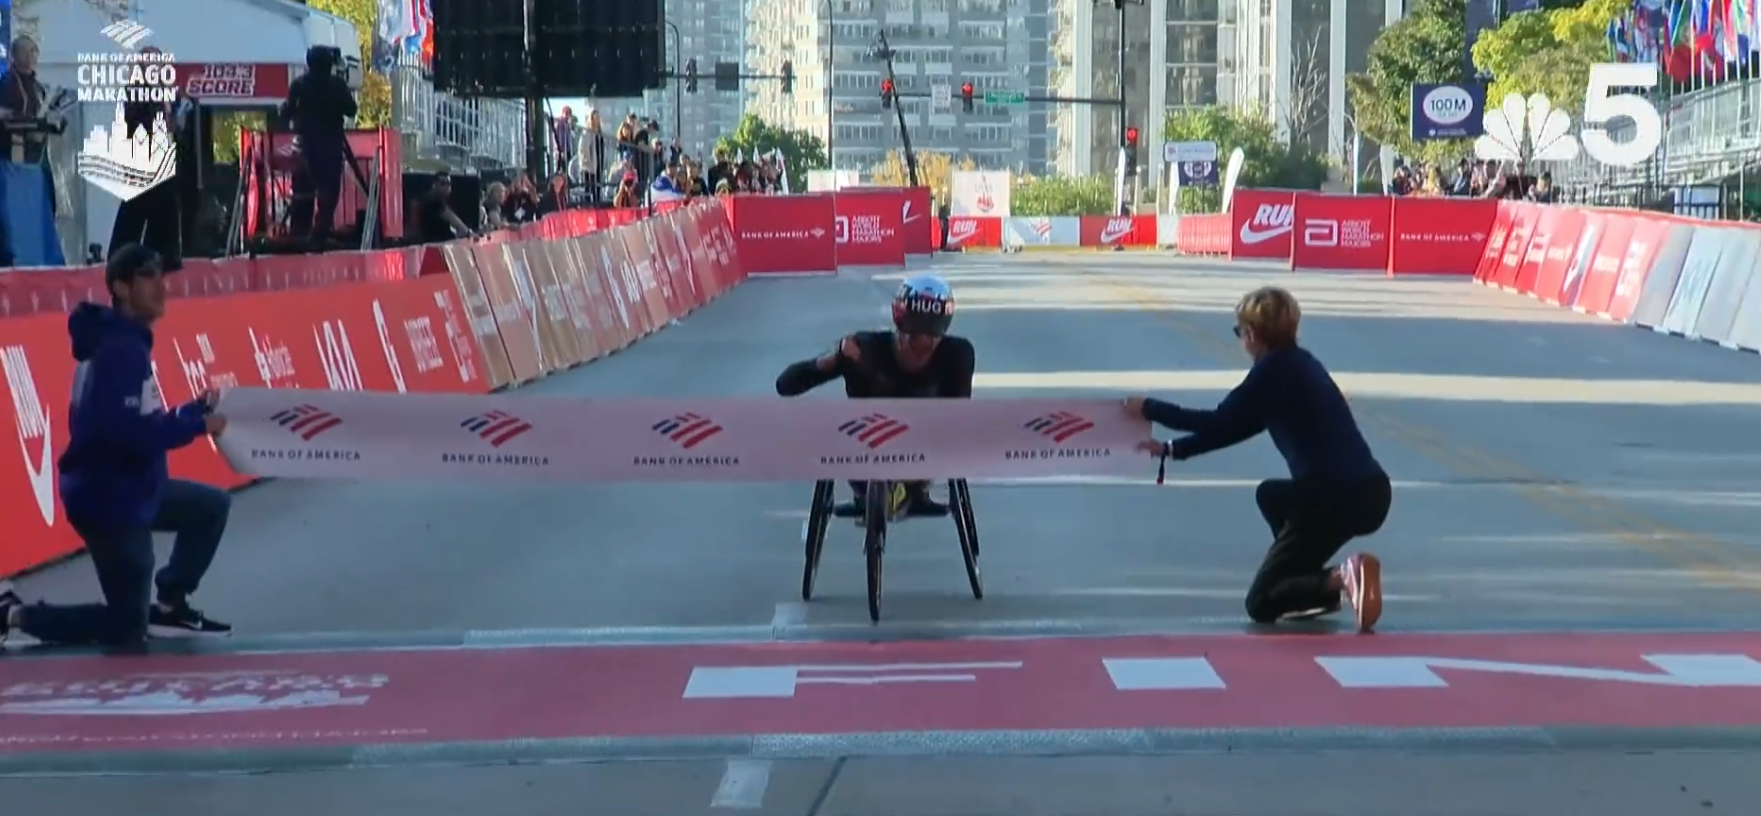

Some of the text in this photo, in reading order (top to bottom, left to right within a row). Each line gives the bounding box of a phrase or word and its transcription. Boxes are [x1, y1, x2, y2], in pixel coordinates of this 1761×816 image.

[953, 220, 977, 233] RUN
[1107, 219, 1132, 232] RUN
[741, 230, 809, 239] BANK OF AMERICA
[1400, 232, 1422, 241] BANK
[1435, 232, 1470, 242] AMERICA
[911, 299, 942, 314] HUG
[251, 449, 361, 460] BANK OF AMERICA
[442, 453, 549, 466] BANK OF AMERICA
[633, 455, 739, 465] BANK OF AMERICA
[820, 453, 926, 465] BANK OF AMERICA
[1005, 448, 1111, 460] BANK OF AMERICA
